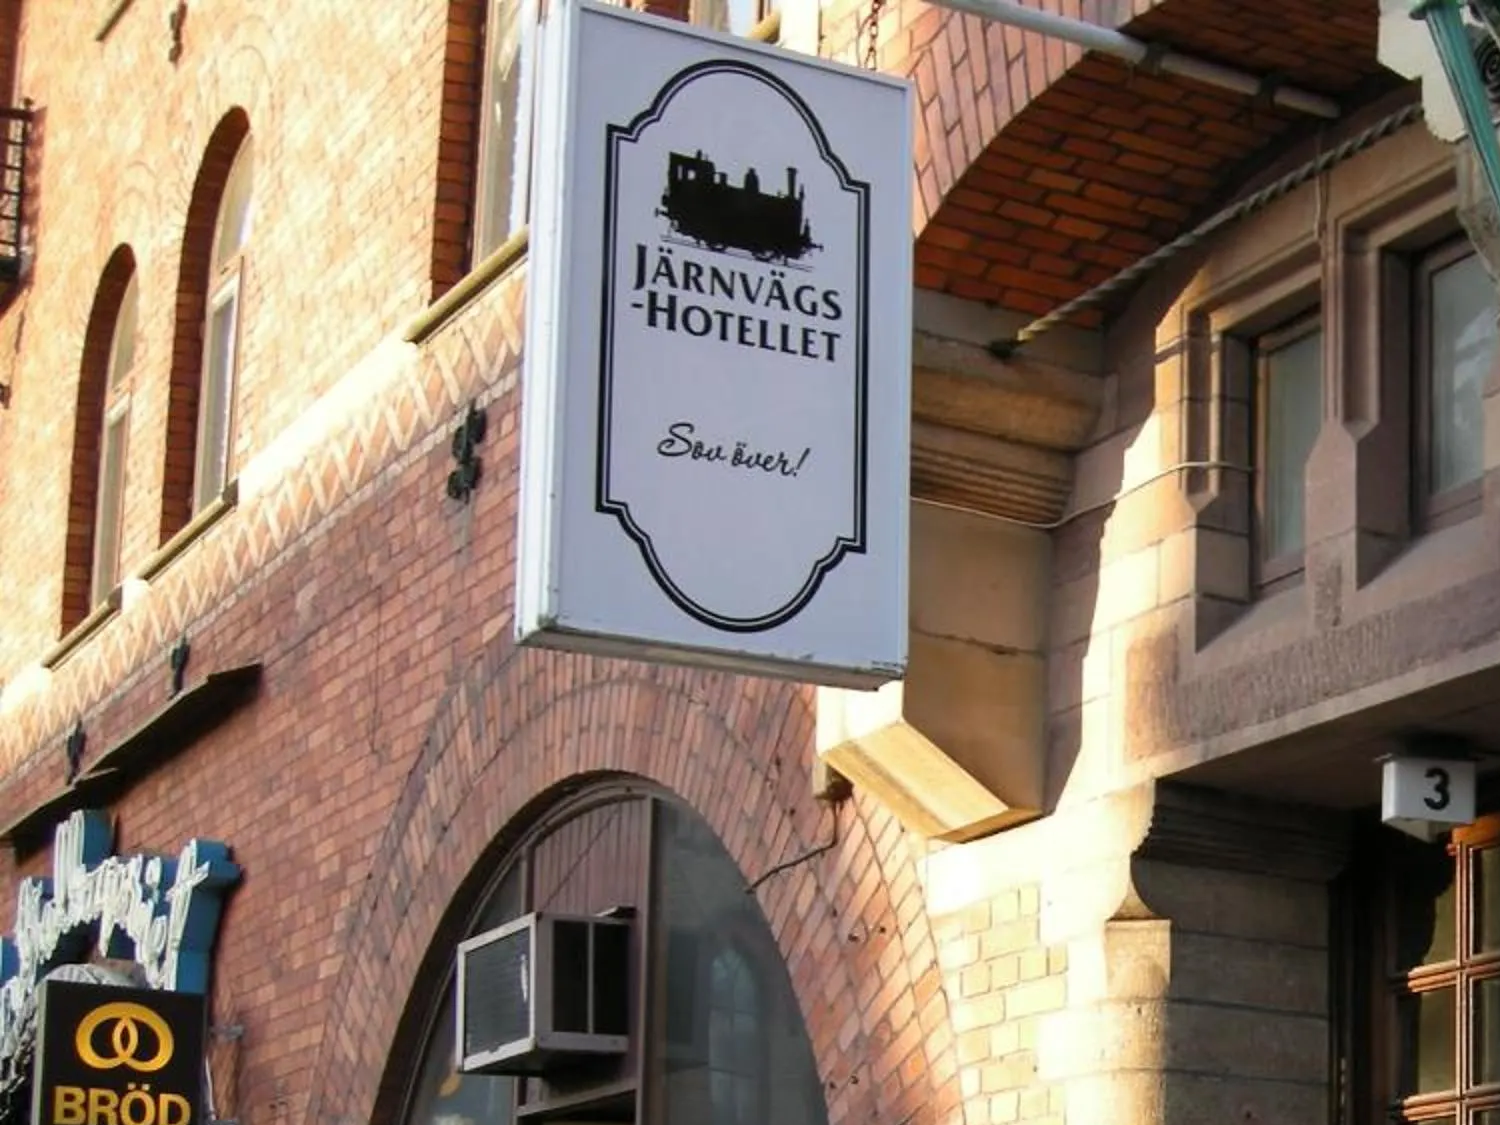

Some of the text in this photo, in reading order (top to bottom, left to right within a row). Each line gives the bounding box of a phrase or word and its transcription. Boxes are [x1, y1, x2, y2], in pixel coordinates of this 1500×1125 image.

[632, 243, 843, 321] JÄRNVÄGS
[631, 290, 840, 362] -HOTELLET
[657, 422, 810, 476] Sov över!
[1424, 767, 1450, 810] 3
